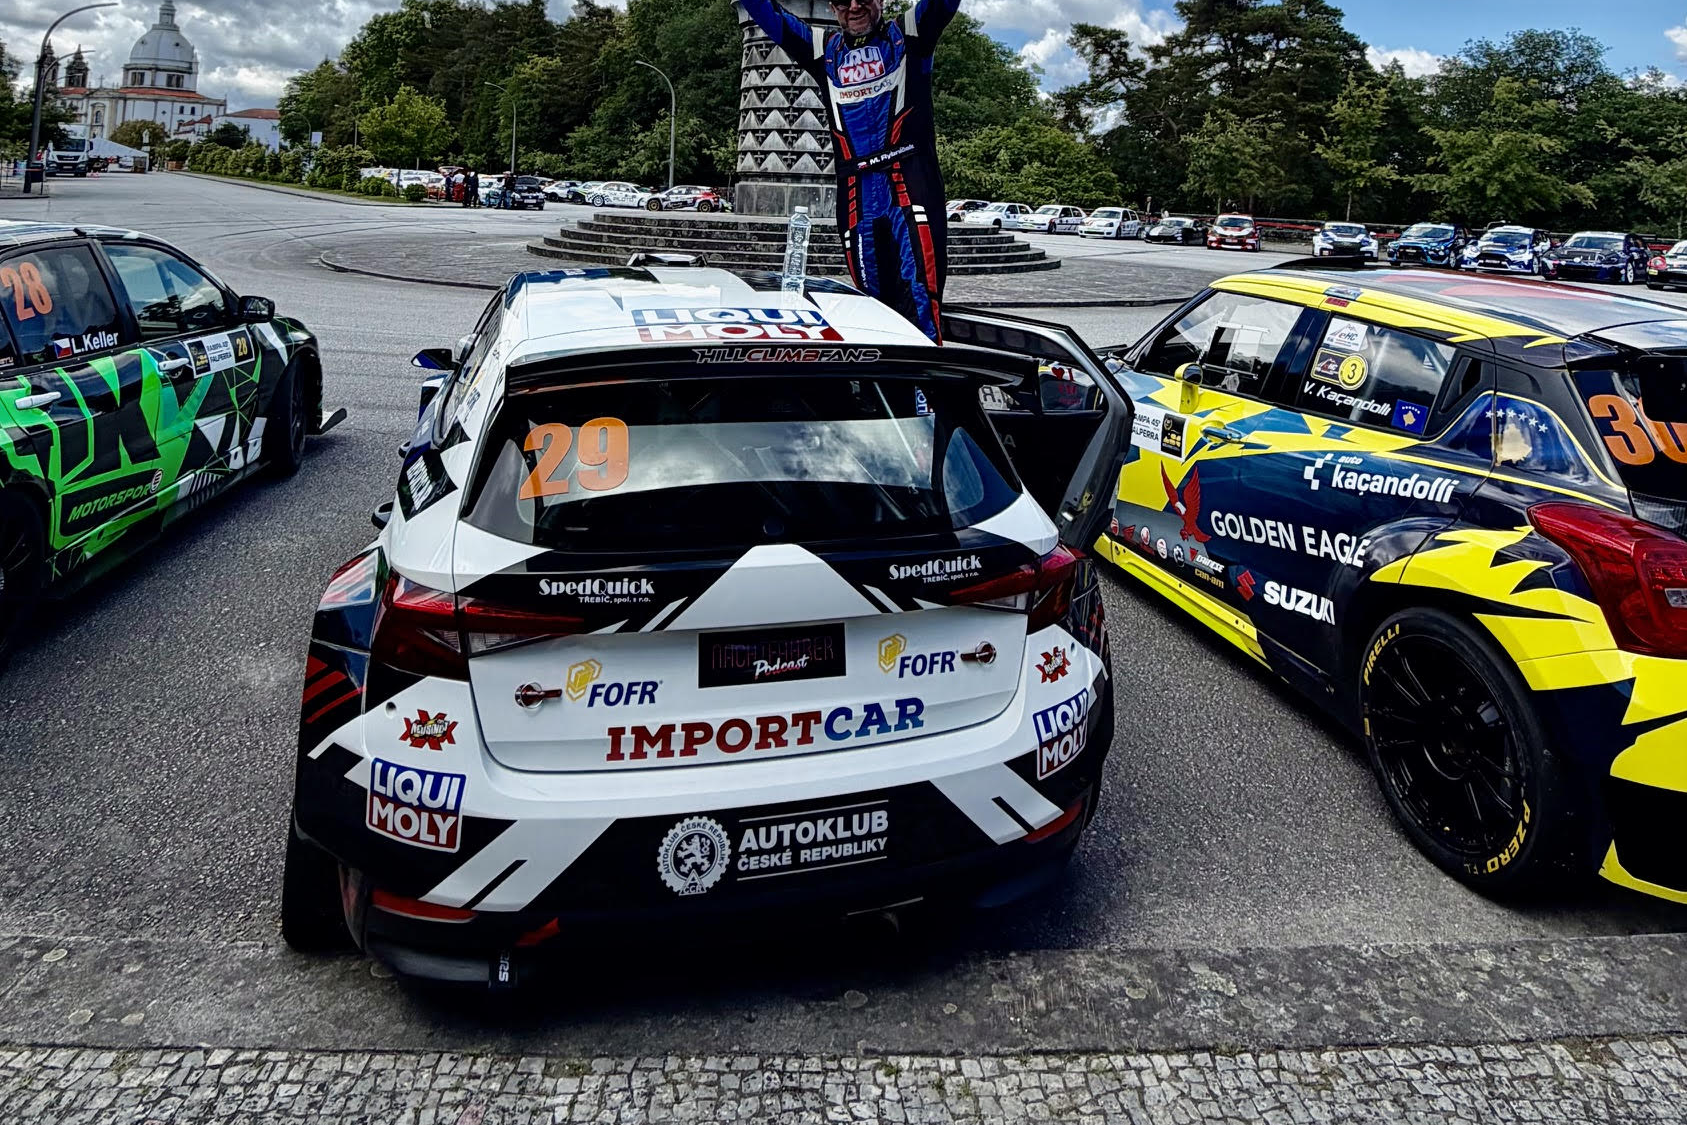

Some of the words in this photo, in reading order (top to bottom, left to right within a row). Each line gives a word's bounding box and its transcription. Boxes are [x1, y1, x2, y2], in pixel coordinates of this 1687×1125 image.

[840, 61, 882, 84] MOLY
[0, 261, 53, 321] 28
[71, 330, 119, 354] L.Keller
[235, 337, 248, 357] 28
[649, 324, 832, 342] MOLY
[691, 348, 883, 363] HILLCLIMBFANS
[1347, 362, 1358, 380] 3
[1303, 380, 1316, 395] V.
[519, 416, 629, 501] 29
[1337, 455, 1364, 466] auto
[67, 482, 152, 524] MOTORSPOR
[1331, 464, 1460, 504] kaçandolli
[1210, 510, 1298, 552] GOLDEN
[1302, 525, 1371, 569] EAGLE
[888, 554, 982, 580] SpedQuick
[538, 578, 656, 596] SpedQuick
[1263, 580, 1336, 626] SUZUKI
[753, 653, 809, 681] Podcast
[898, 651, 956, 679] FOFR
[1363, 623, 1401, 686] PIRELLI
[587, 681, 659, 708] FOFR
[1036, 691, 1088, 743] LIQUI
[1041, 718, 1087, 773] MOLY
[373, 761, 461, 811] LIQUI
[372, 795, 457, 845] MOLY
[738, 809, 889, 853] AUTOKLUB
[661, 831, 680, 875] AUTOKLUB
[707, 824, 727, 868] REPUBLIKY
[736, 848, 793, 872] ČESKÉ
[799, 836, 888, 864] REPUBLIKY
[1486, 819, 1527, 874] ZERO
